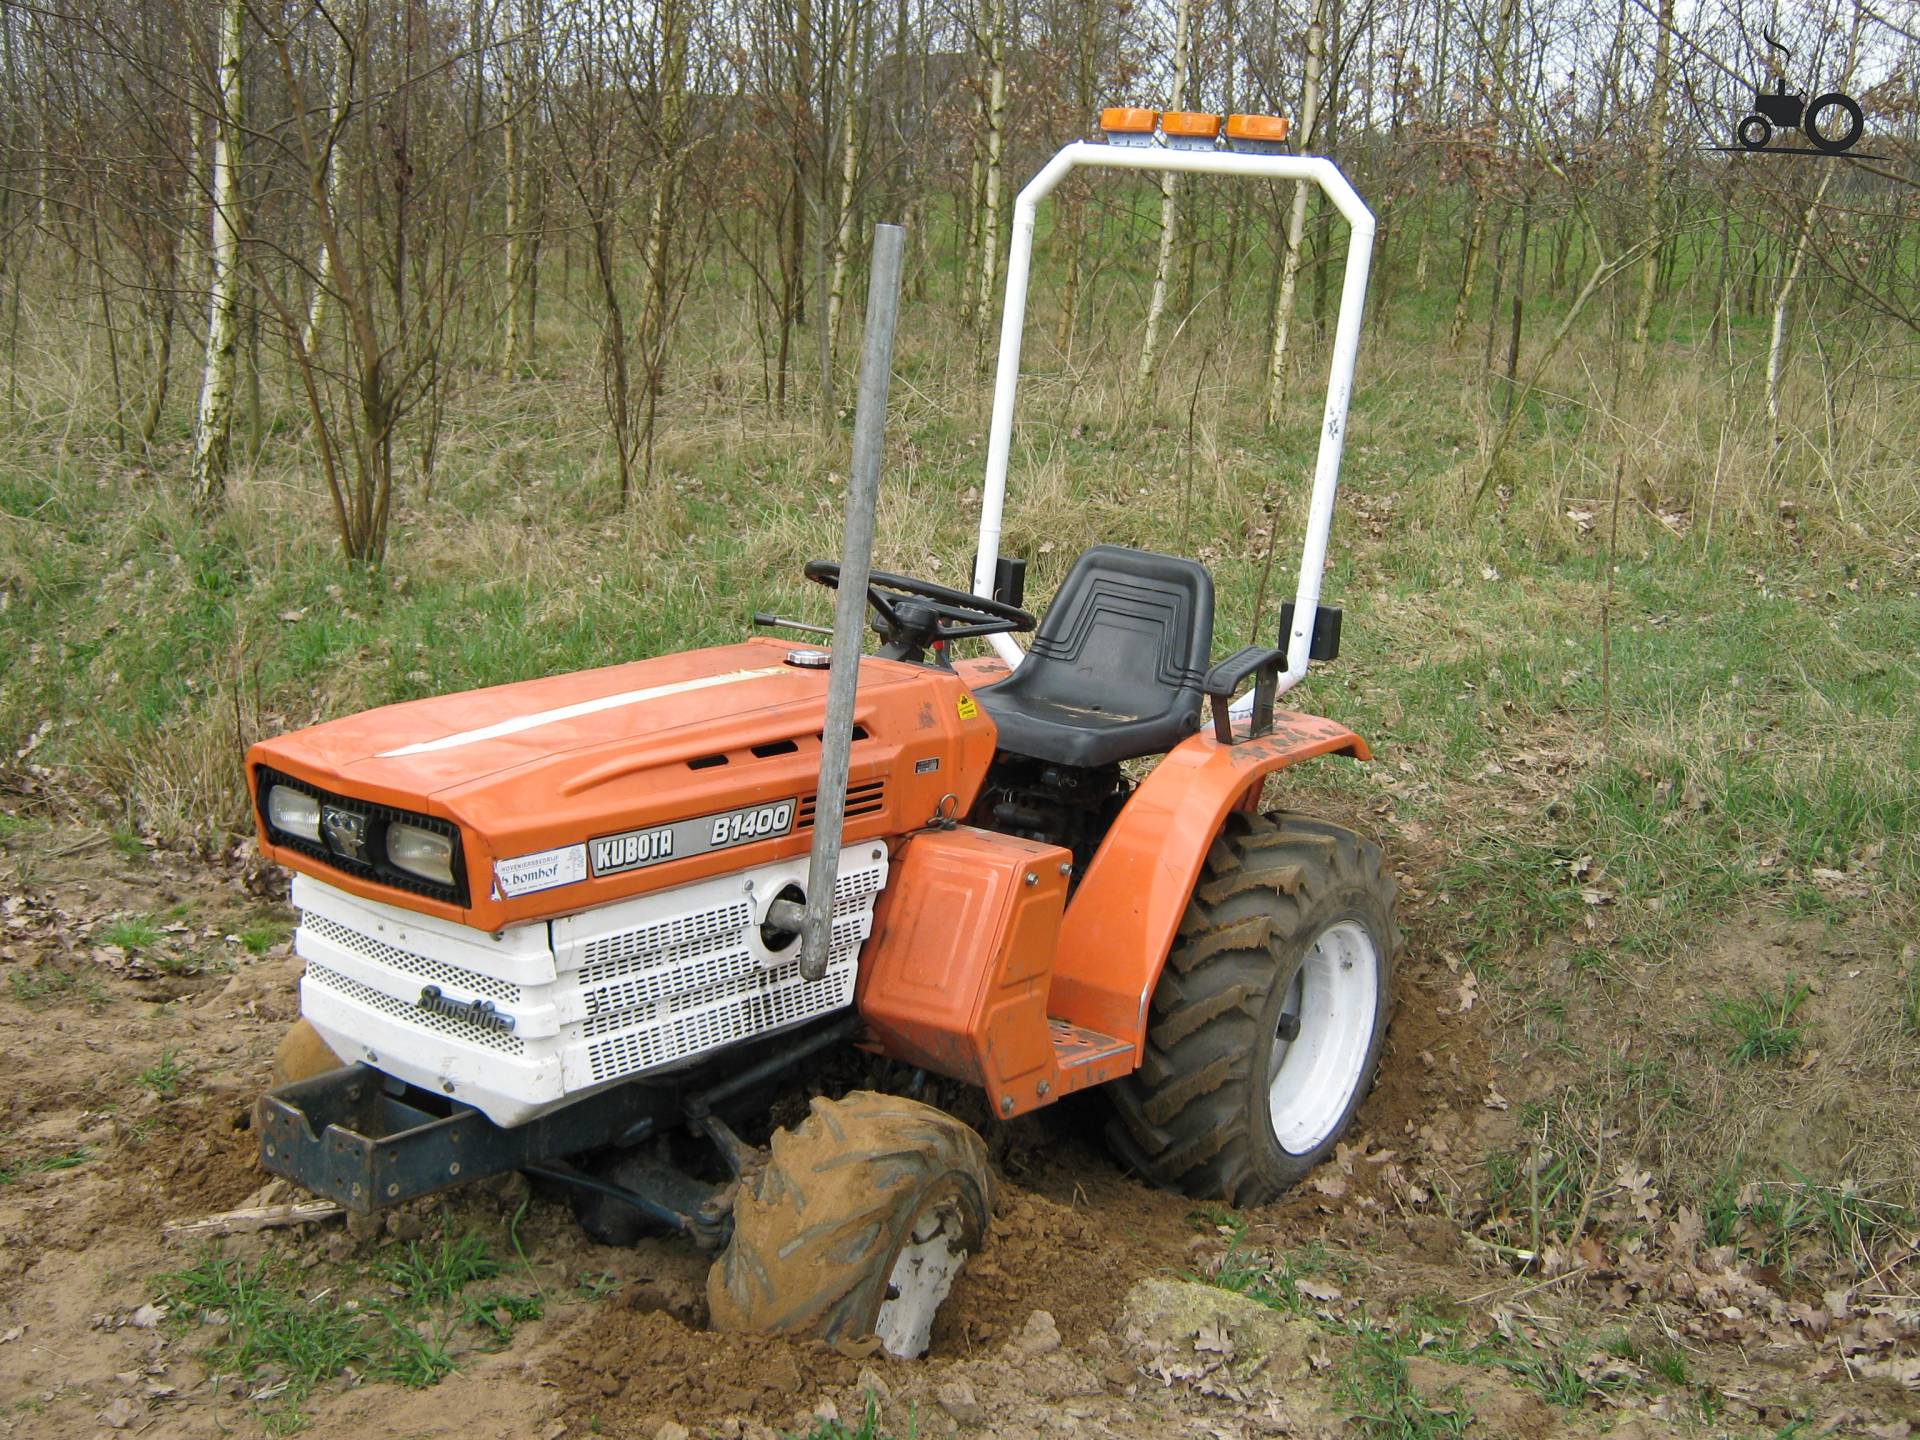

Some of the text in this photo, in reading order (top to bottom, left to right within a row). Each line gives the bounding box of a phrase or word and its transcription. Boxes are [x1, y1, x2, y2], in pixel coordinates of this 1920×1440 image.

[597, 804, 791, 871] KUBOTA B1400
[417, 984, 516, 1032] Sunshine
